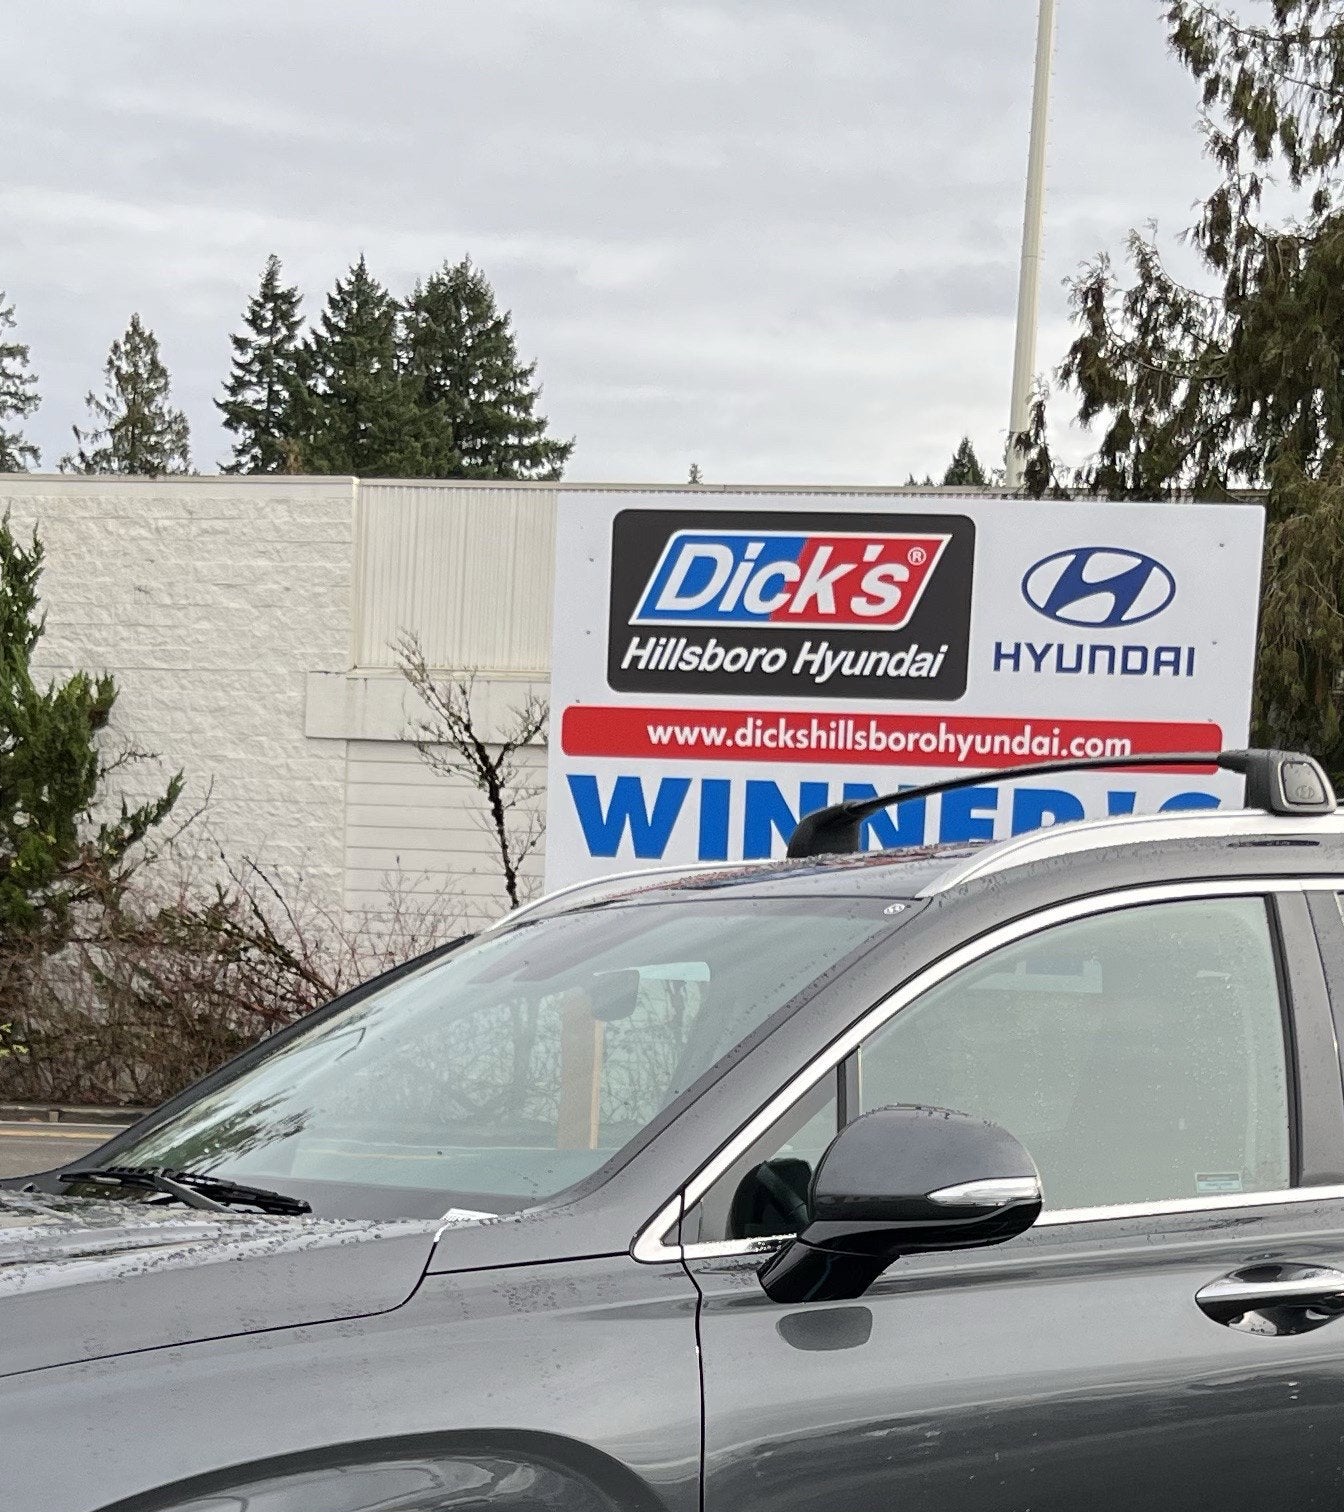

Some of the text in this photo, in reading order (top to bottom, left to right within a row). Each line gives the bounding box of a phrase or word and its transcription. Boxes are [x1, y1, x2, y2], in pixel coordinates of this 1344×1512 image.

[621, 635, 949, 684] Hillsboro Hyundai
[993, 641, 1196, 679] HYUNDAI
[646, 718, 1132, 759] www.dickshillsborohyundai.com
[566, 774, 1221, 860] WINNE'
